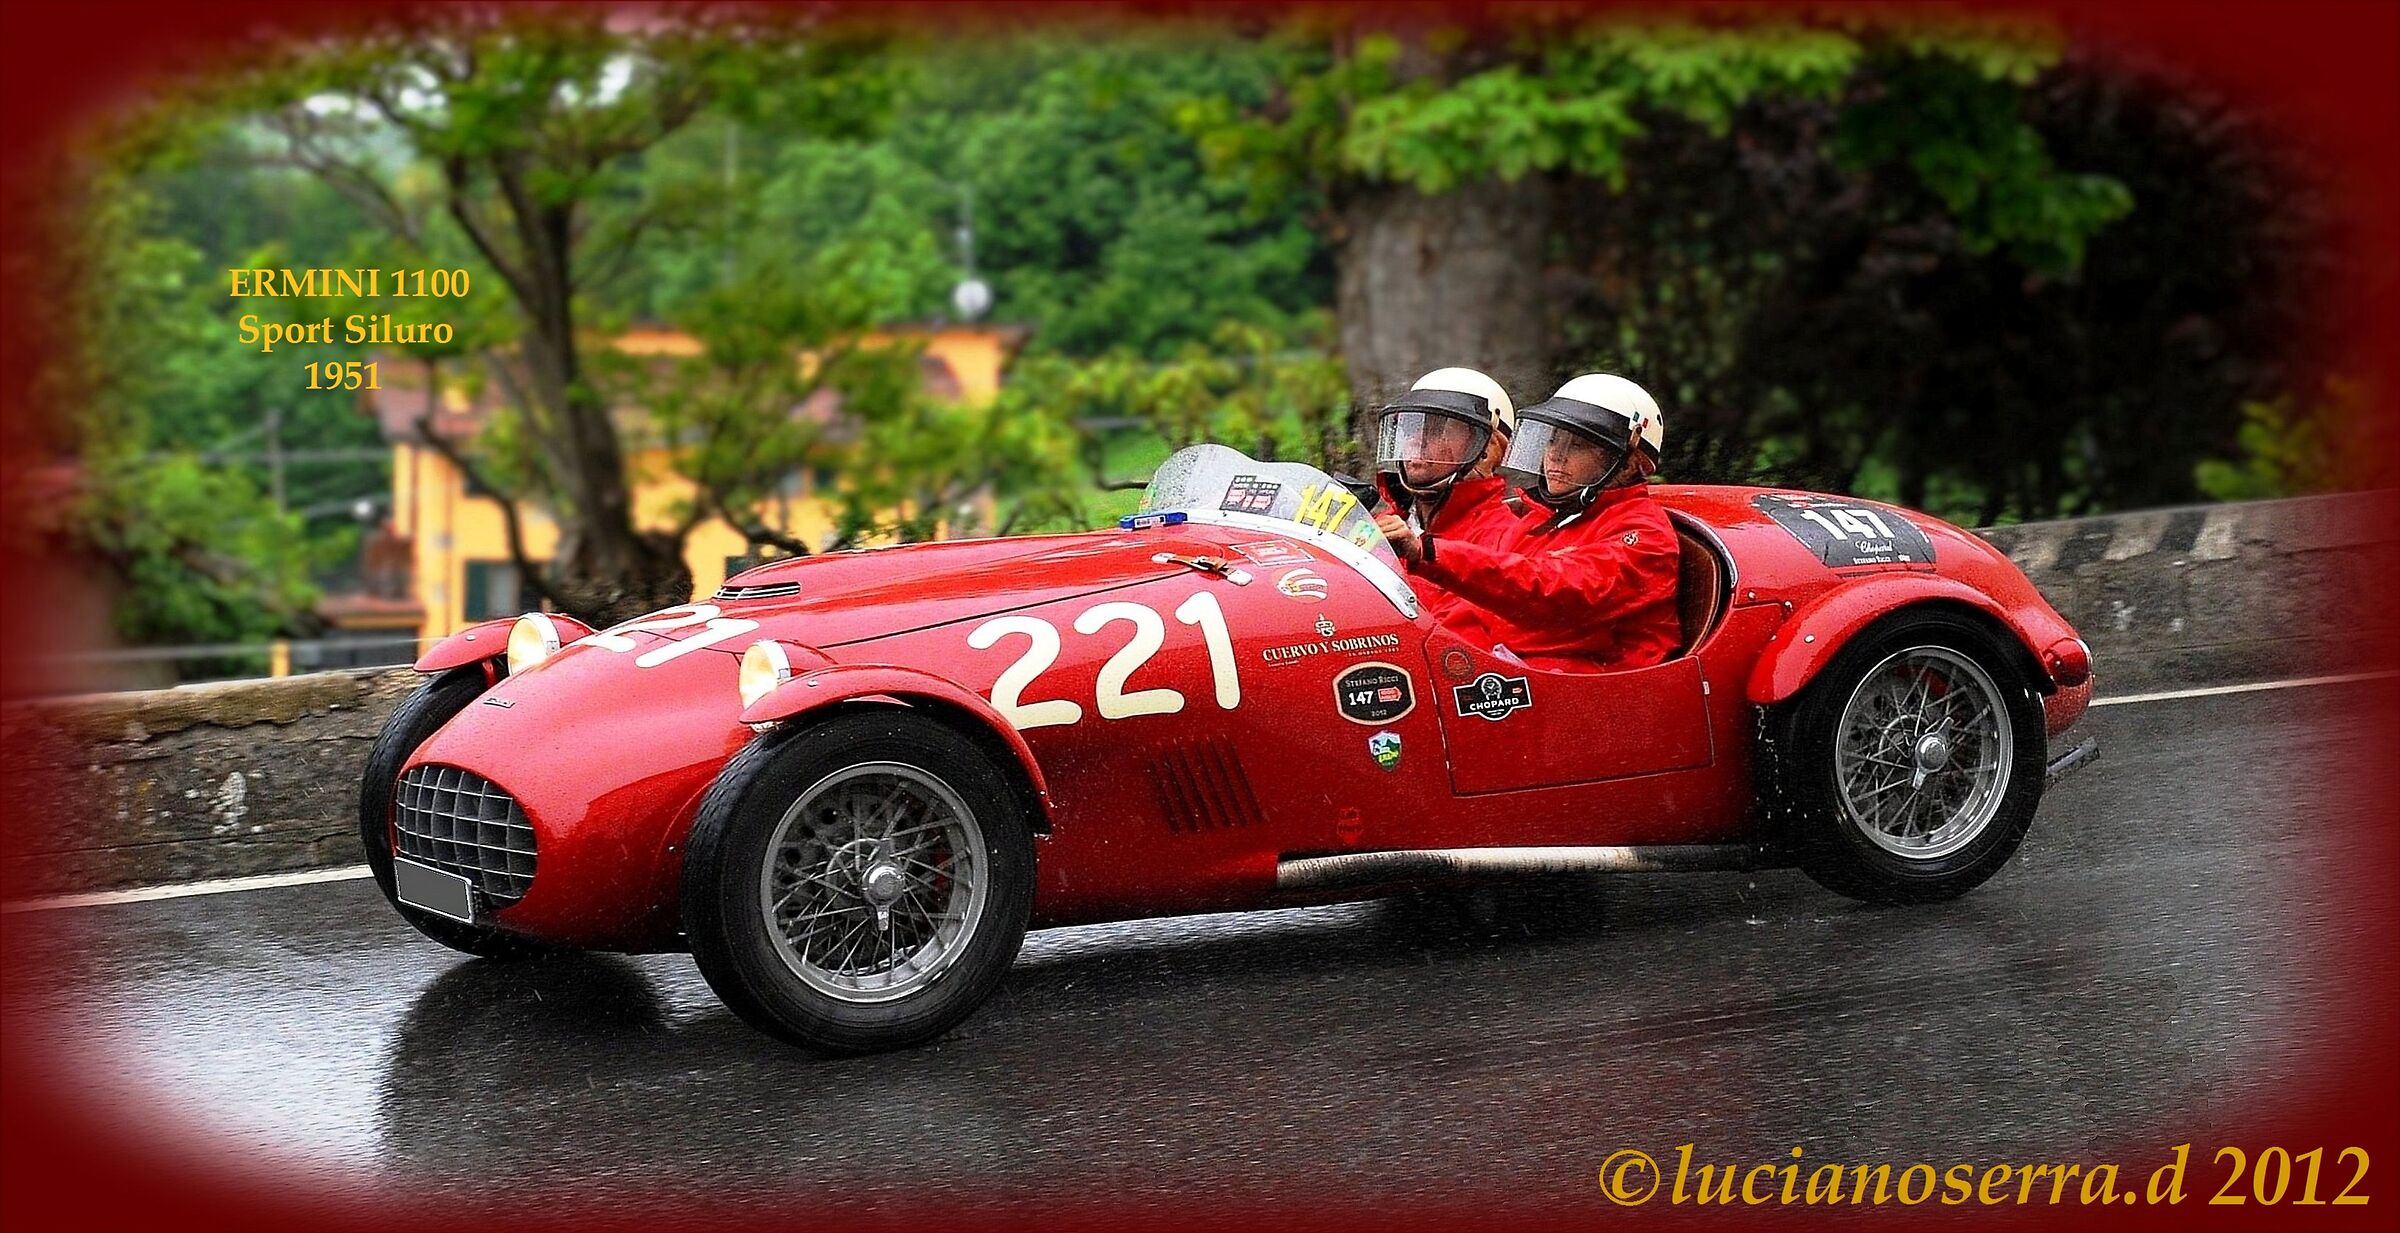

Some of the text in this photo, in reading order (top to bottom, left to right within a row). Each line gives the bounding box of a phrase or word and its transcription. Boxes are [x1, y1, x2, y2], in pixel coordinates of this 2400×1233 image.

[1294, 484, 1357, 533] 147
[1800, 509, 1896, 541] 147
[966, 590, 1241, 731] 221
[1262, 643, 1319, 661] CUERVO
[1320, 641, 1329, 654] Y
[1331, 633, 1399, 652] SOBRINOS
[1348, 690, 1374, 706] 147
[1469, 697, 1520, 711] CHOPARD
